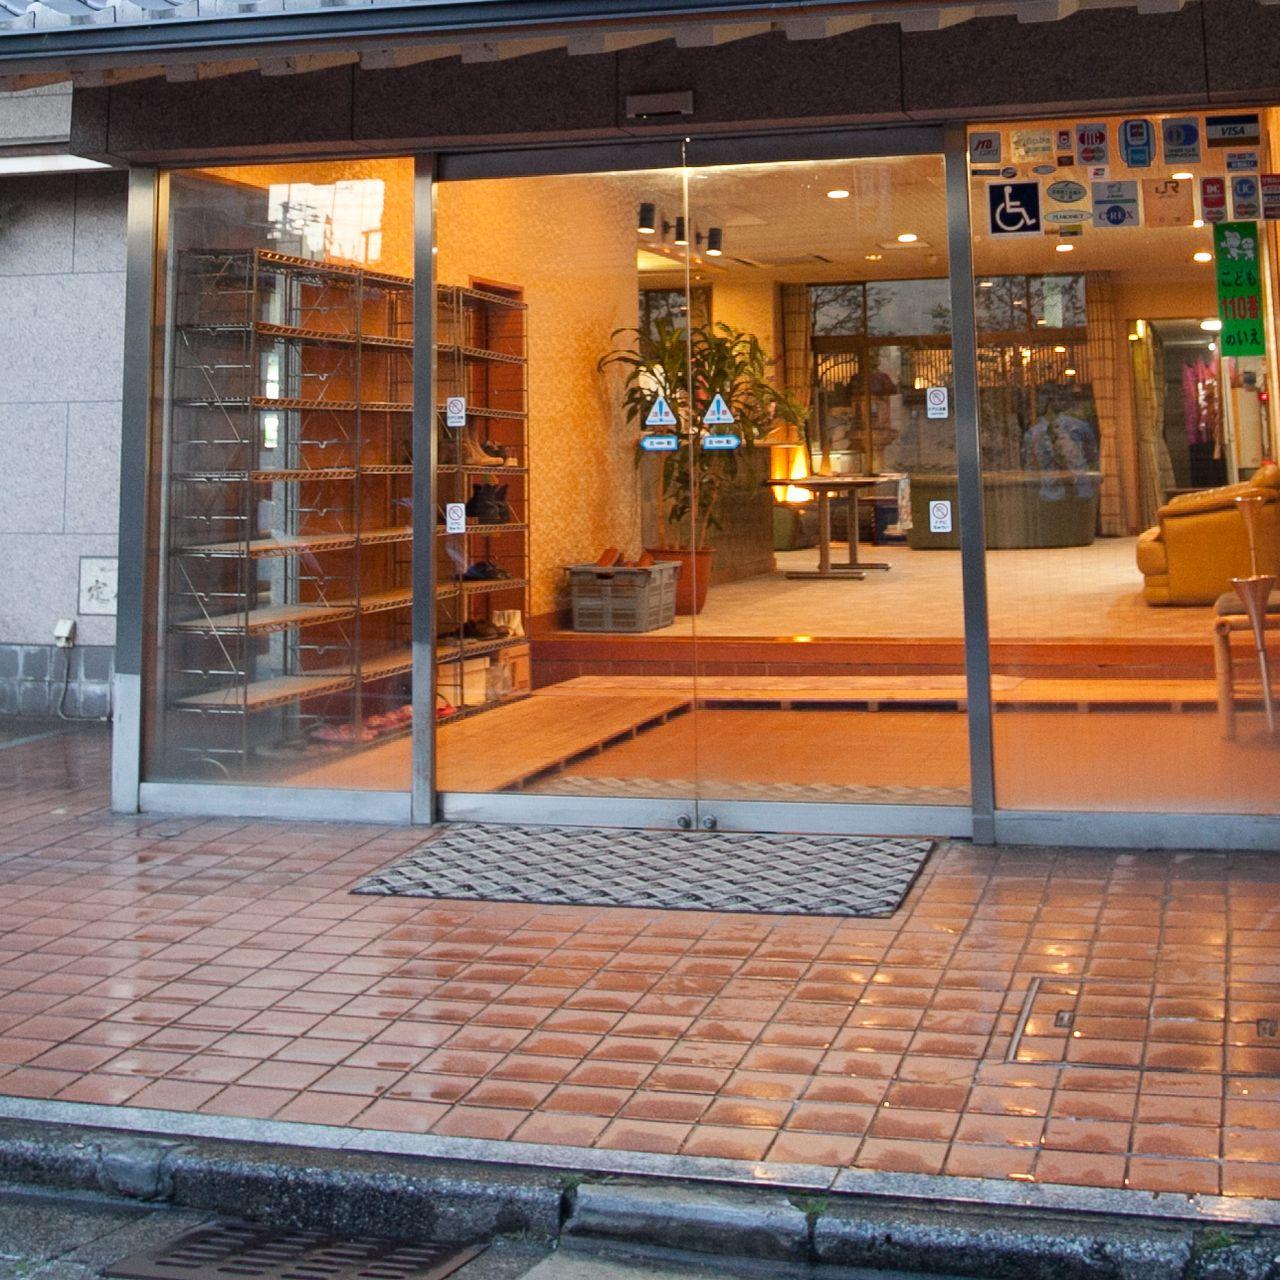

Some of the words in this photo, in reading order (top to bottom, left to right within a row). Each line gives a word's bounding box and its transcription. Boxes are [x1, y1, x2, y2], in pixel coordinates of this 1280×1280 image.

[1221, 126, 1245, 136] VISA
[1155, 181, 1179, 194] JR
[1222, 271, 1256, 287] こども
[1222, 295, 1259, 319] 110番
[1226, 328, 1261, 346] のいえ
